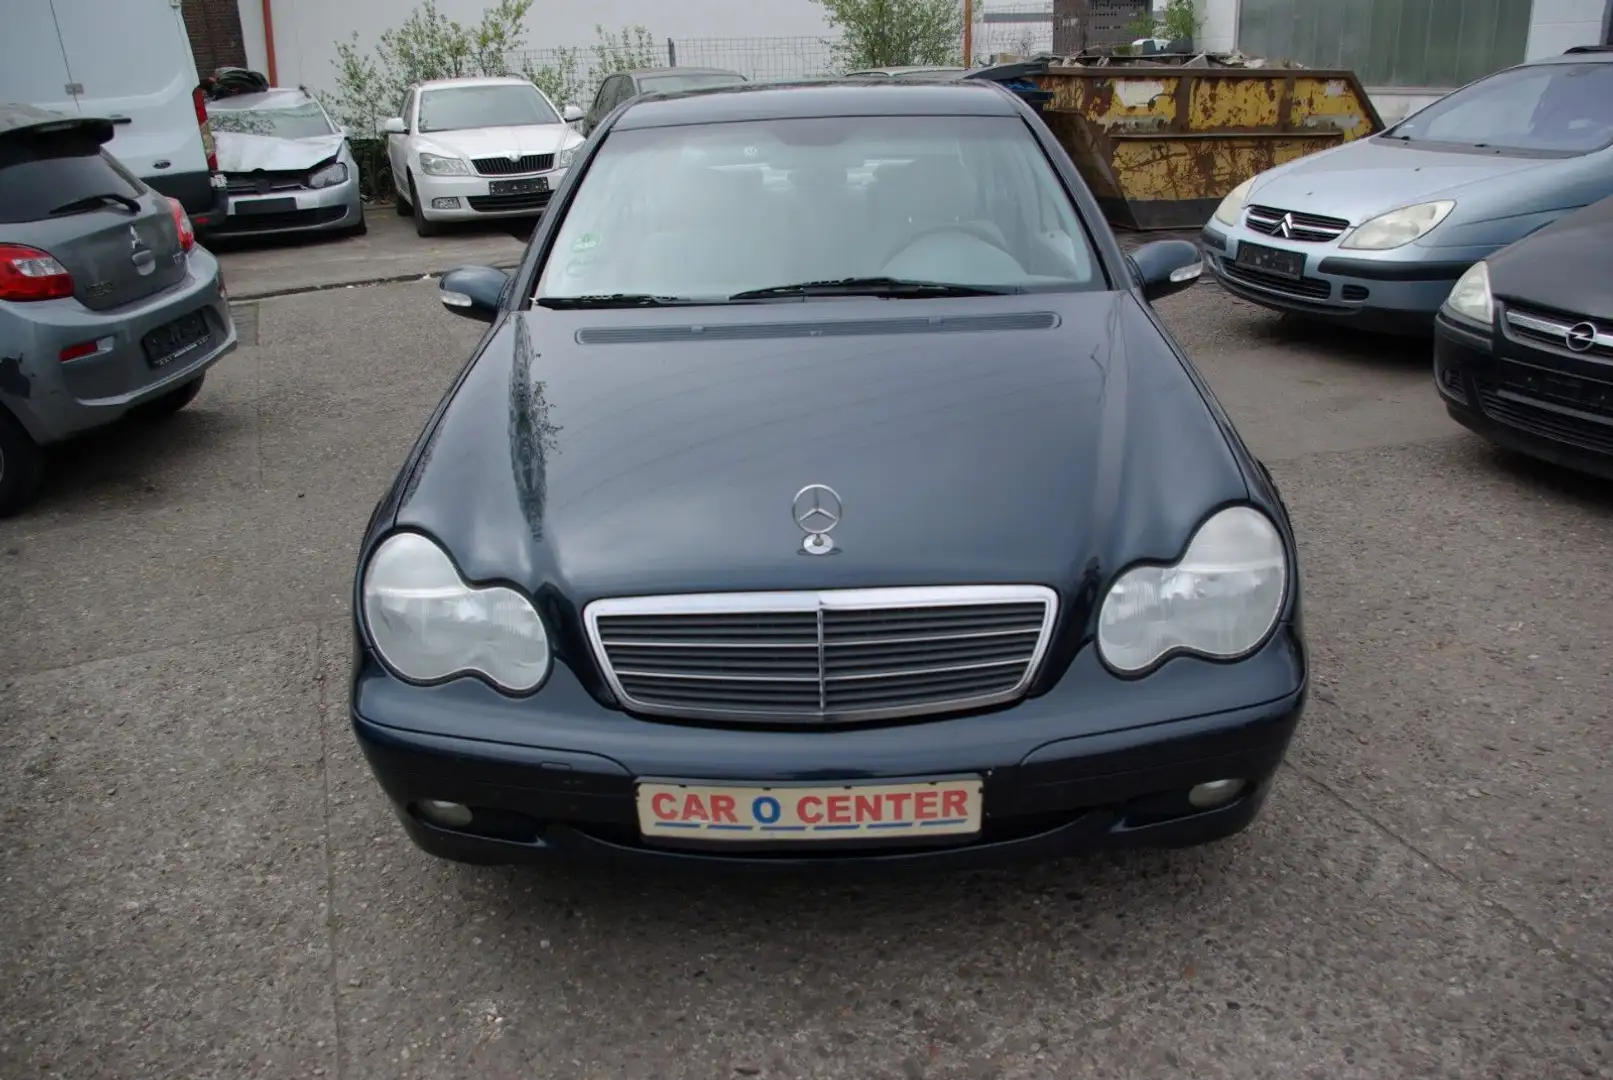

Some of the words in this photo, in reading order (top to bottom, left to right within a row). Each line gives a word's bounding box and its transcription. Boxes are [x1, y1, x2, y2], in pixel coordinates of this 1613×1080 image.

[651, 792, 738, 823] CAR
[752, 796, 781, 824] O
[796, 790, 968, 823] CENTER
